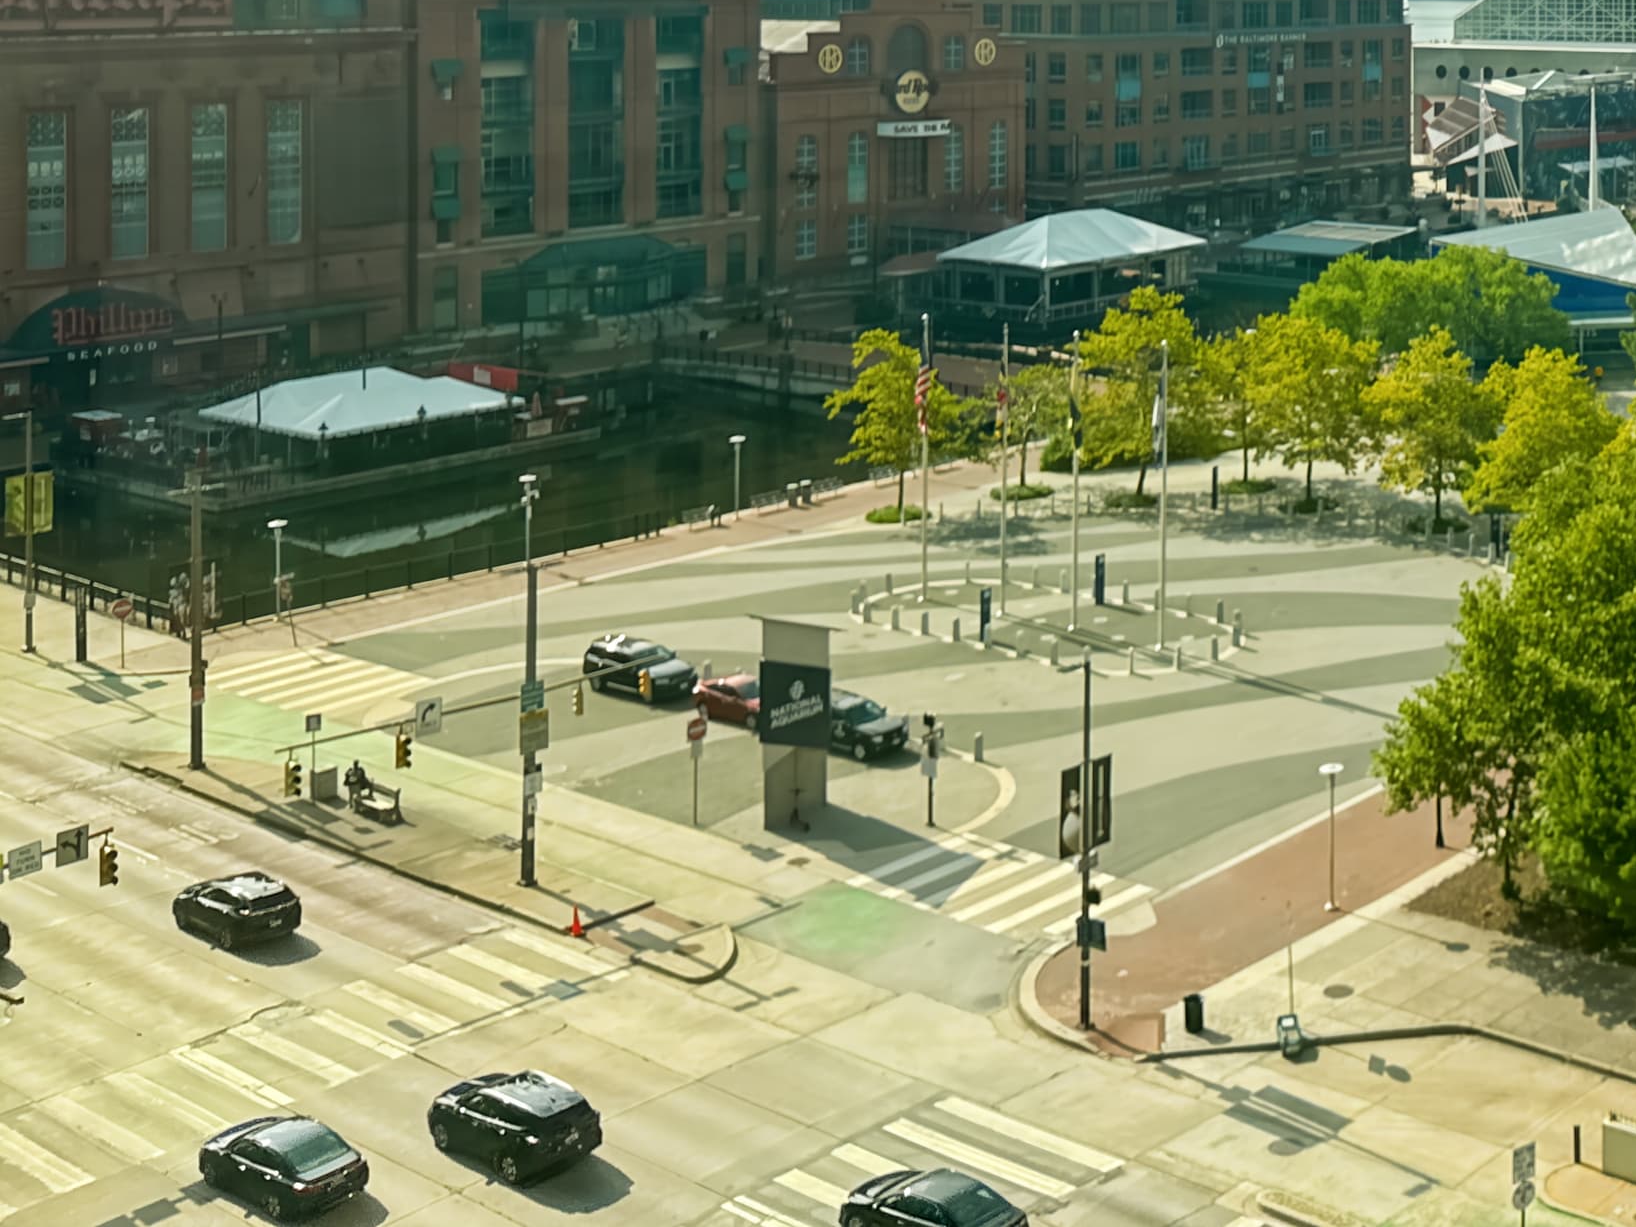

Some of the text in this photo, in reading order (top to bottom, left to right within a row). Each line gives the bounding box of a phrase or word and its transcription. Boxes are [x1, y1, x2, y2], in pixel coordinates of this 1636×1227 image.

[52, 303, 174, 345] Phillips
[67, 341, 157, 362] SEAFOOD
[770, 694, 822, 719] NATIONAL
[770, 704, 824, 729] AQUARIUM
